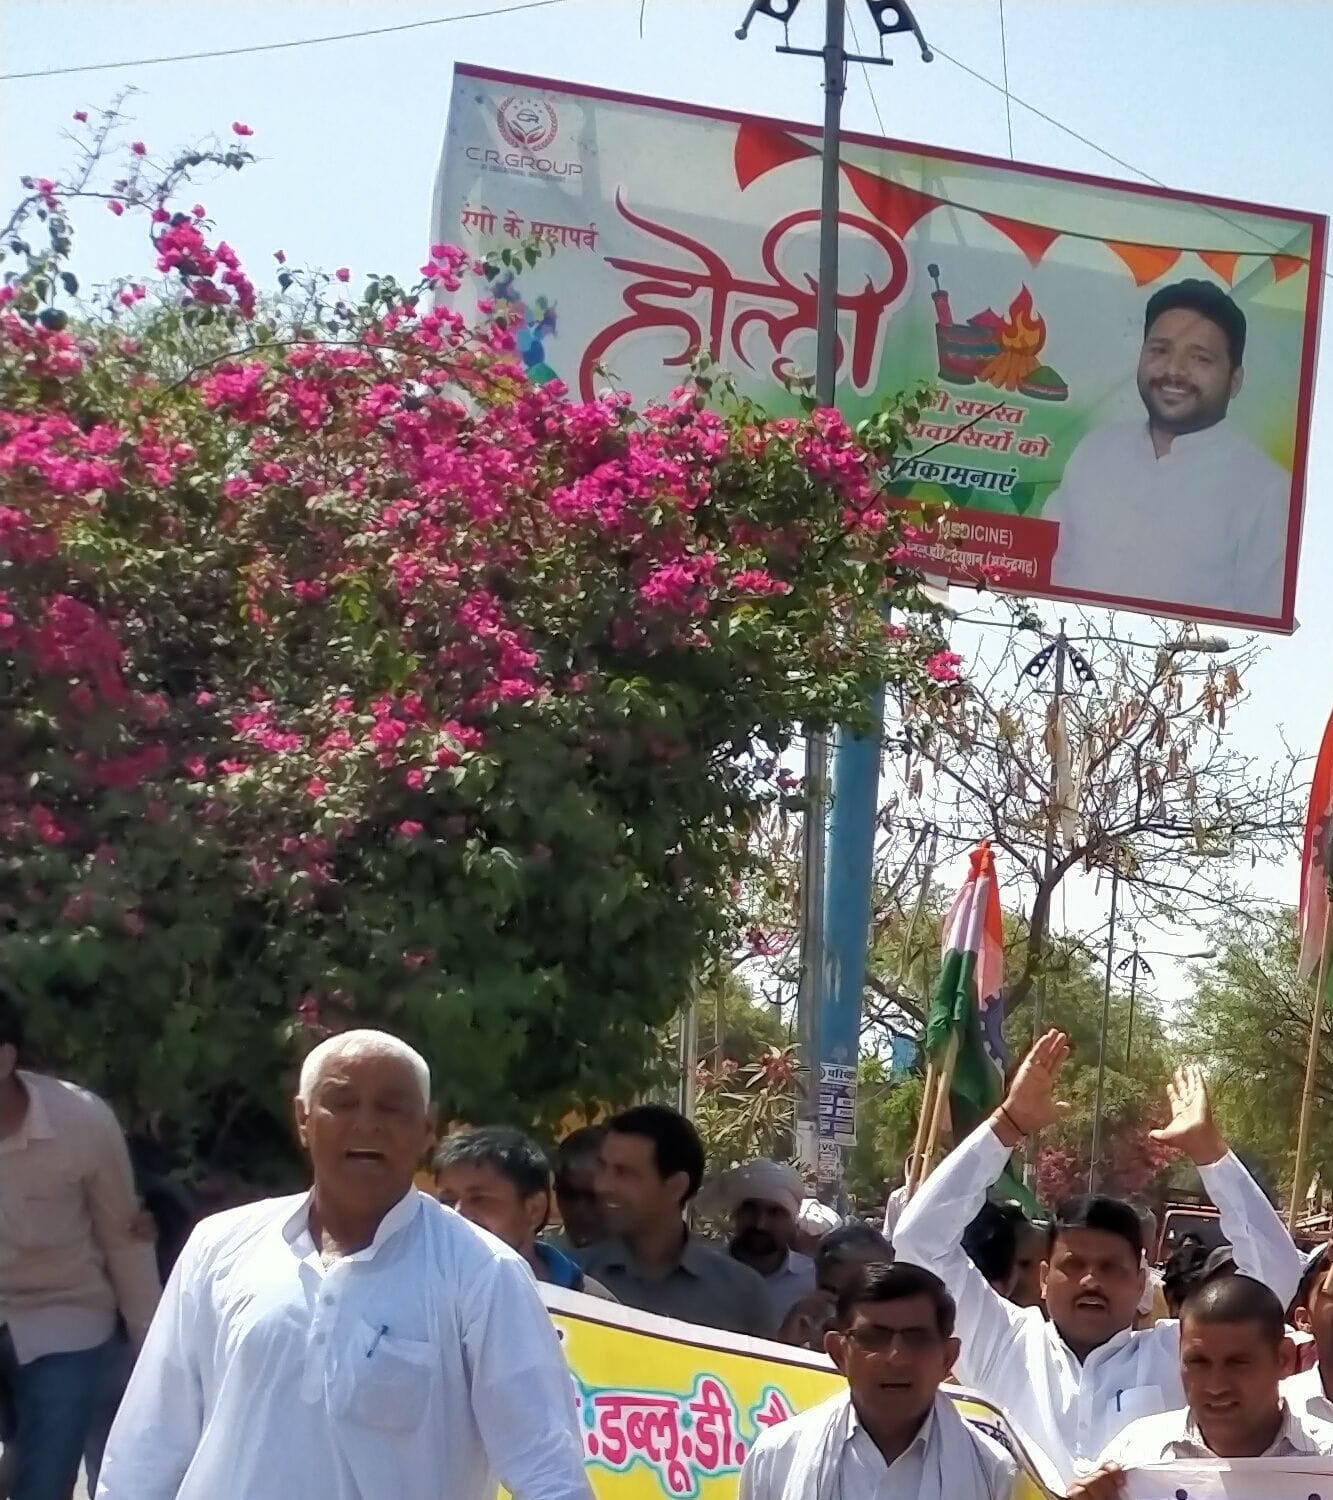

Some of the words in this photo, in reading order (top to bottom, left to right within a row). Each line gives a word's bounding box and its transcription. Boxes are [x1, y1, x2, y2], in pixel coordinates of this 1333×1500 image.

[503, 209, 524, 239] के
[579, 185, 908, 405] होली
[1018, 436, 1052, 459] को
